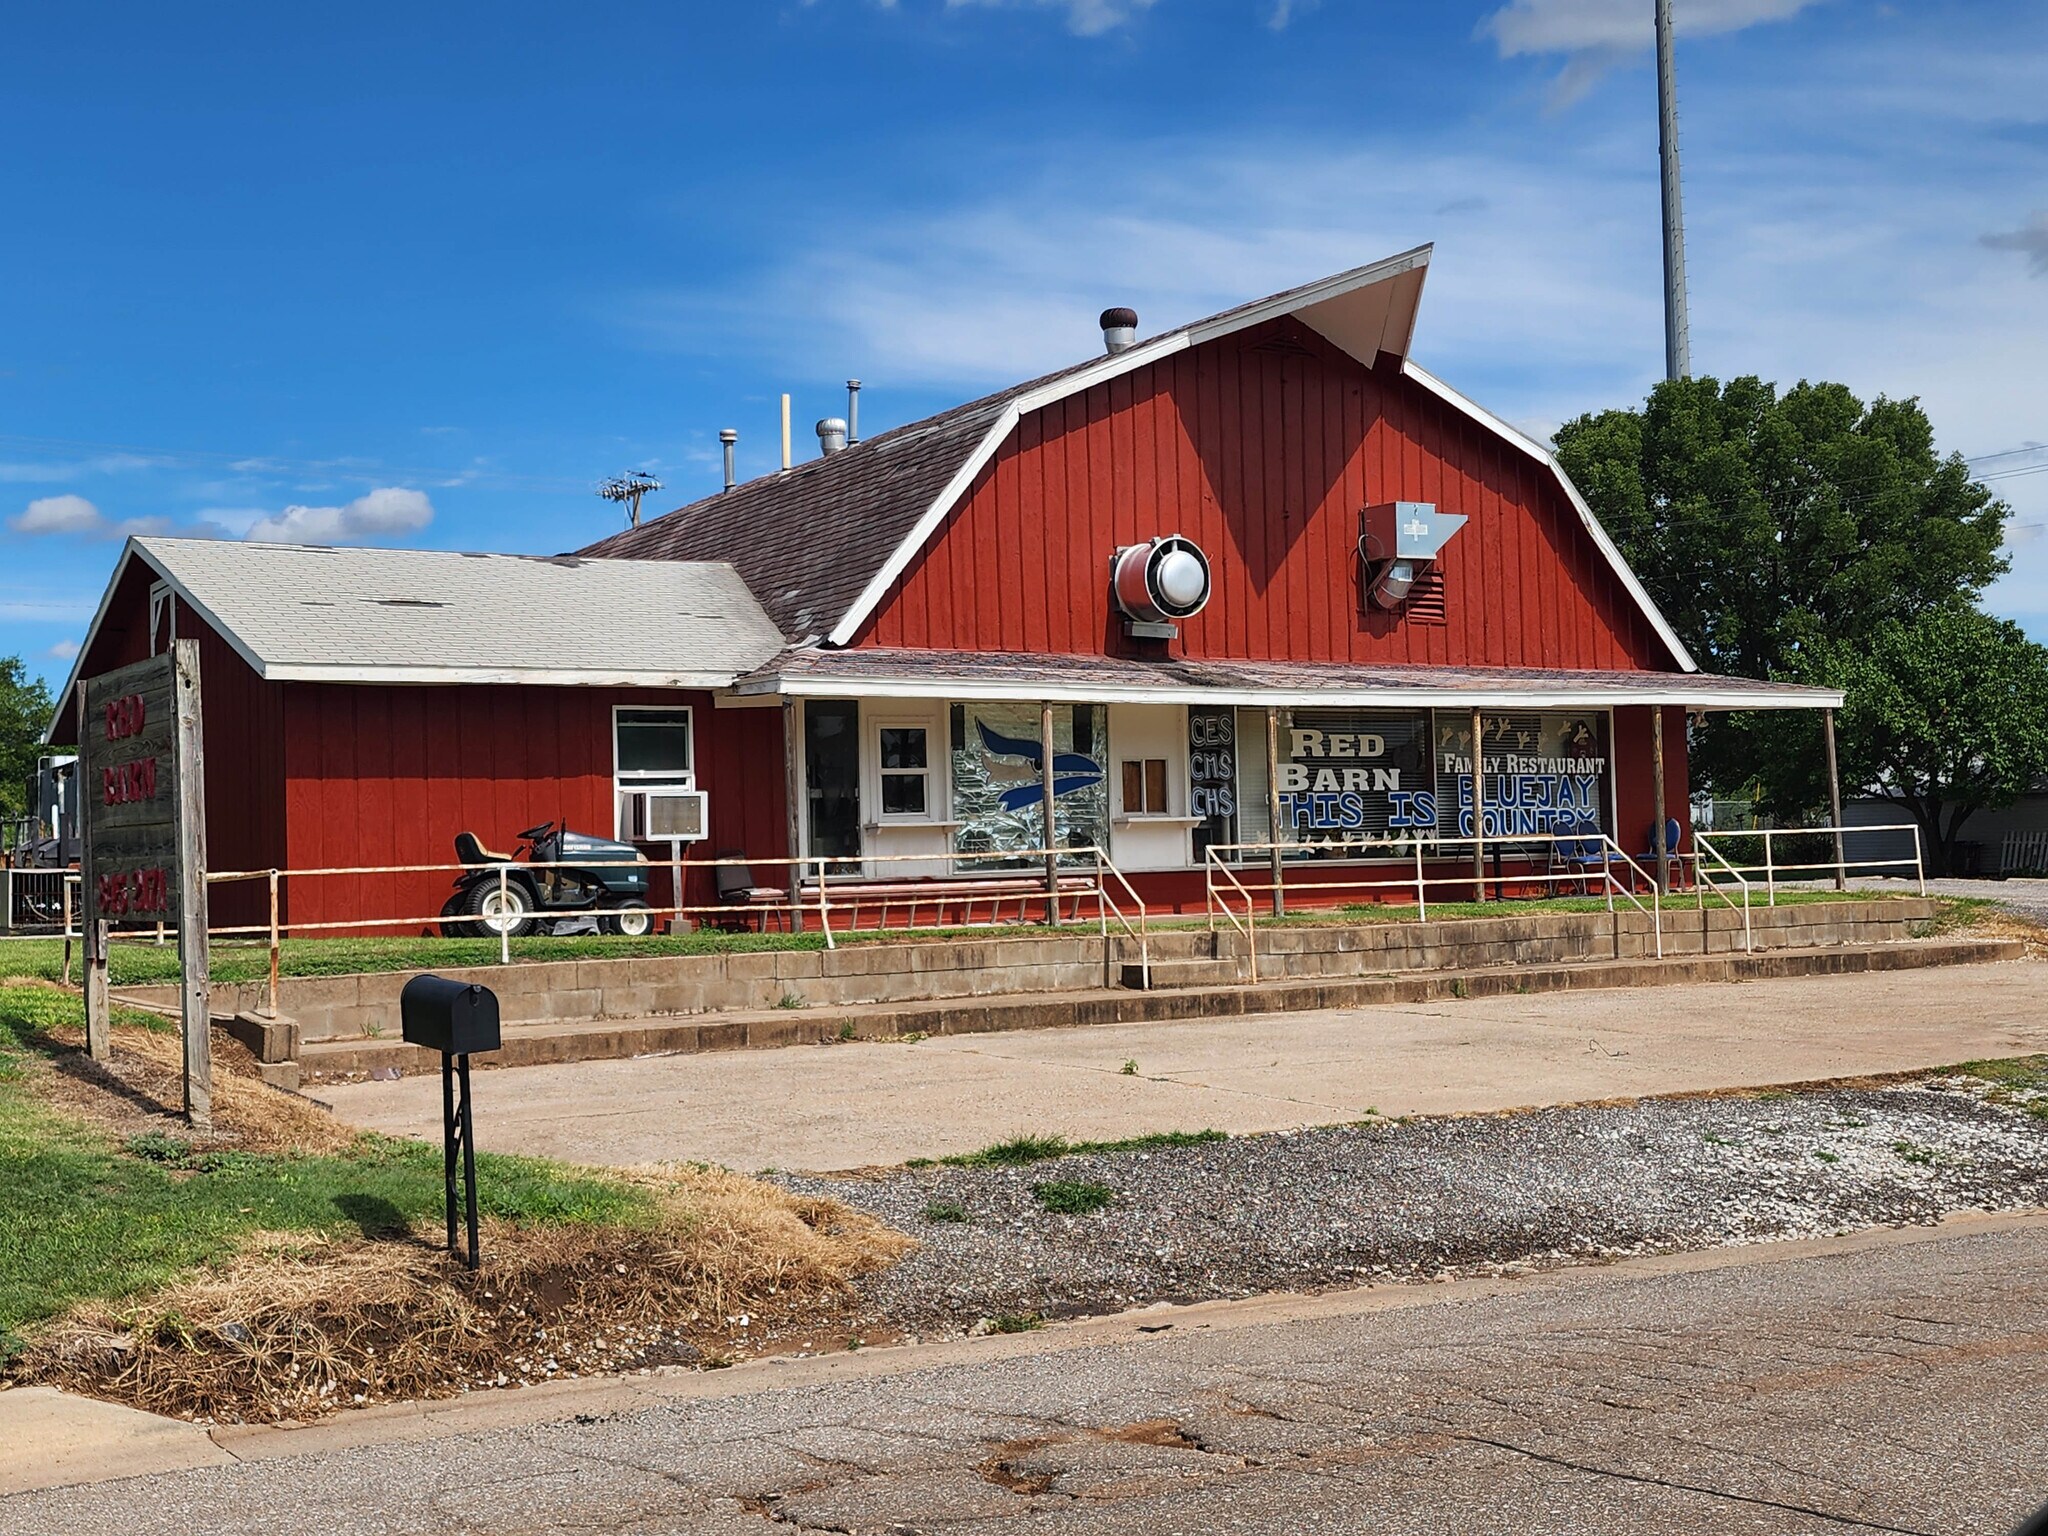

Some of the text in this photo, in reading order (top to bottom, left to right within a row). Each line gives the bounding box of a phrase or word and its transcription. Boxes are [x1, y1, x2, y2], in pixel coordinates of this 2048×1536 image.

[105, 694, 145, 741] RED
[1190, 714, 1234, 748] CES
[1290, 729, 1385, 757] RED
[1190, 750, 1234, 781] CMS
[1279, 763, 1401, 792] BARN
[1444, 753, 1605, 774] FAMLY RESTAURANT
[103, 757, 156, 806] BARN
[1458, 775, 1595, 809] BLUEJAY
[1192, 786, 1236, 818] CHS
[1267, 791, 1438, 829] THIS IS
